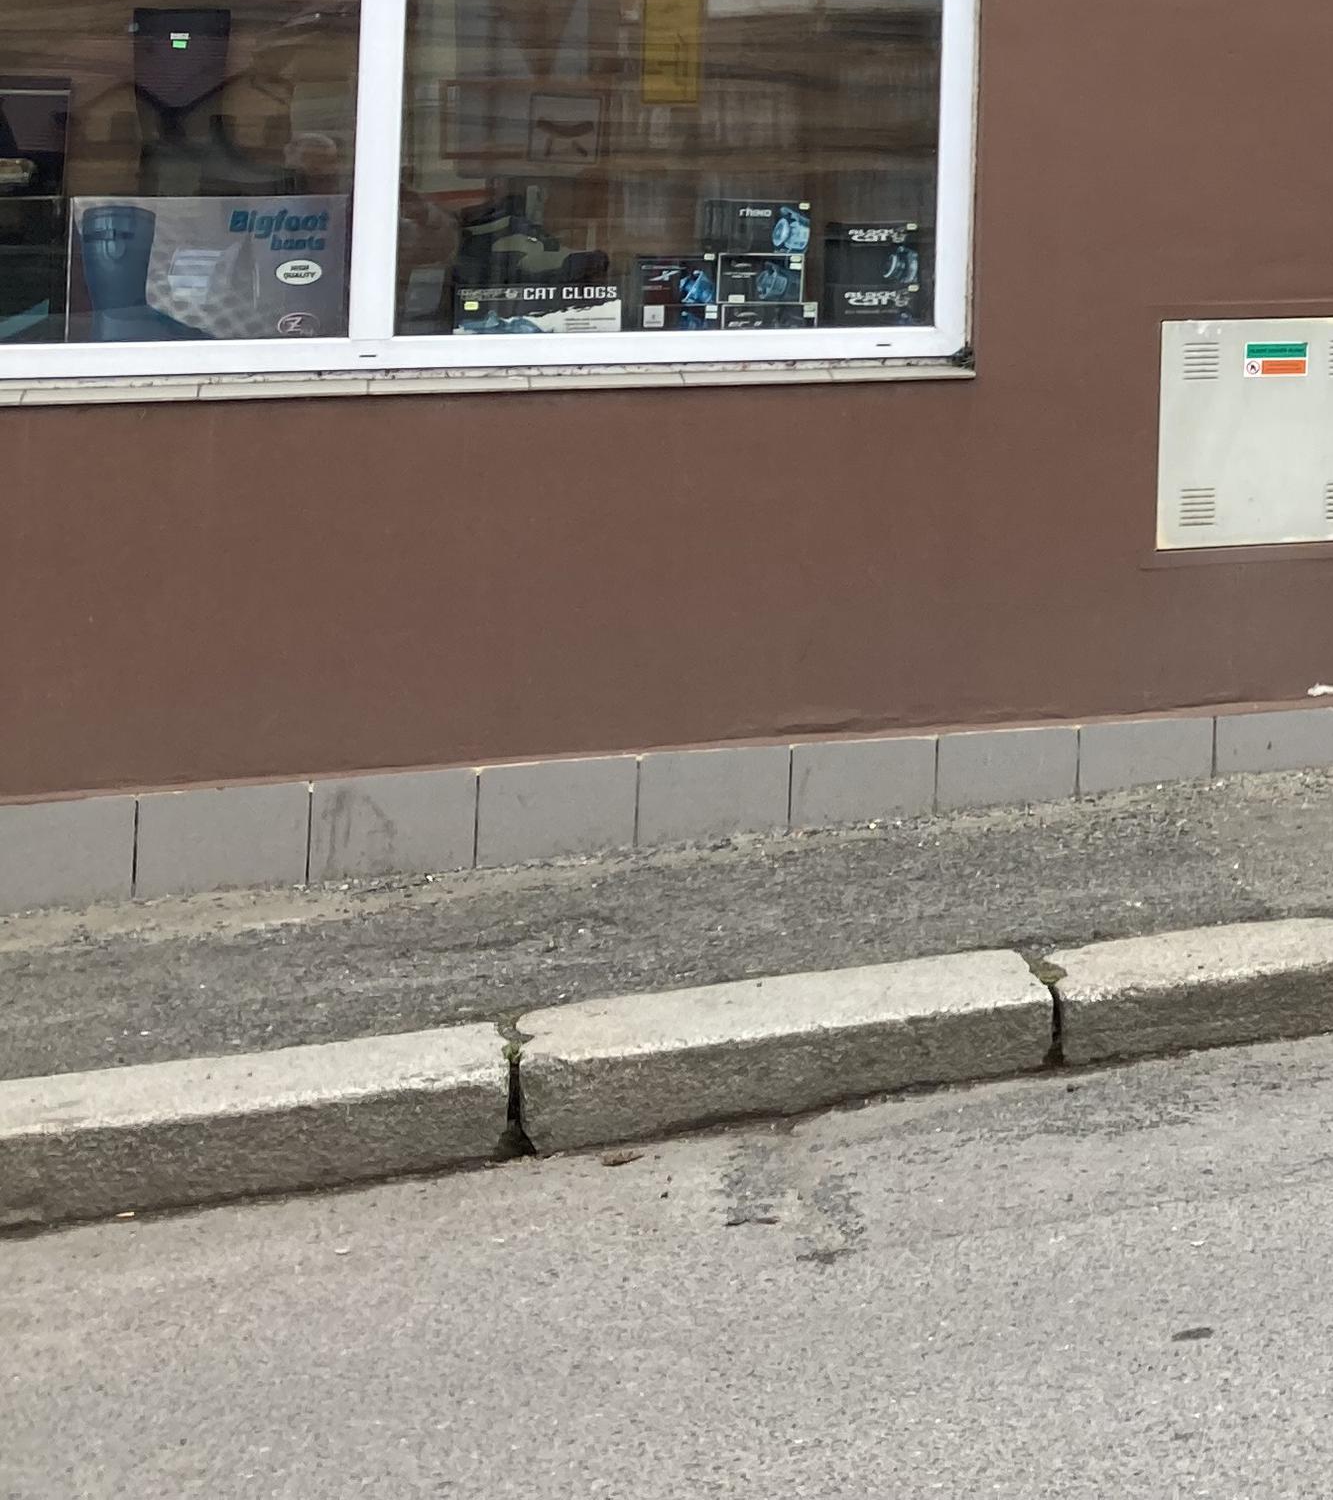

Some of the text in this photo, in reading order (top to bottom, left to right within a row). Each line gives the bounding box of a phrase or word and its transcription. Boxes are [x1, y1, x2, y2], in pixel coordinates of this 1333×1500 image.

[229, 208, 329, 239] Bigfoot
[523, 285, 617, 300] CAT CLOGS
